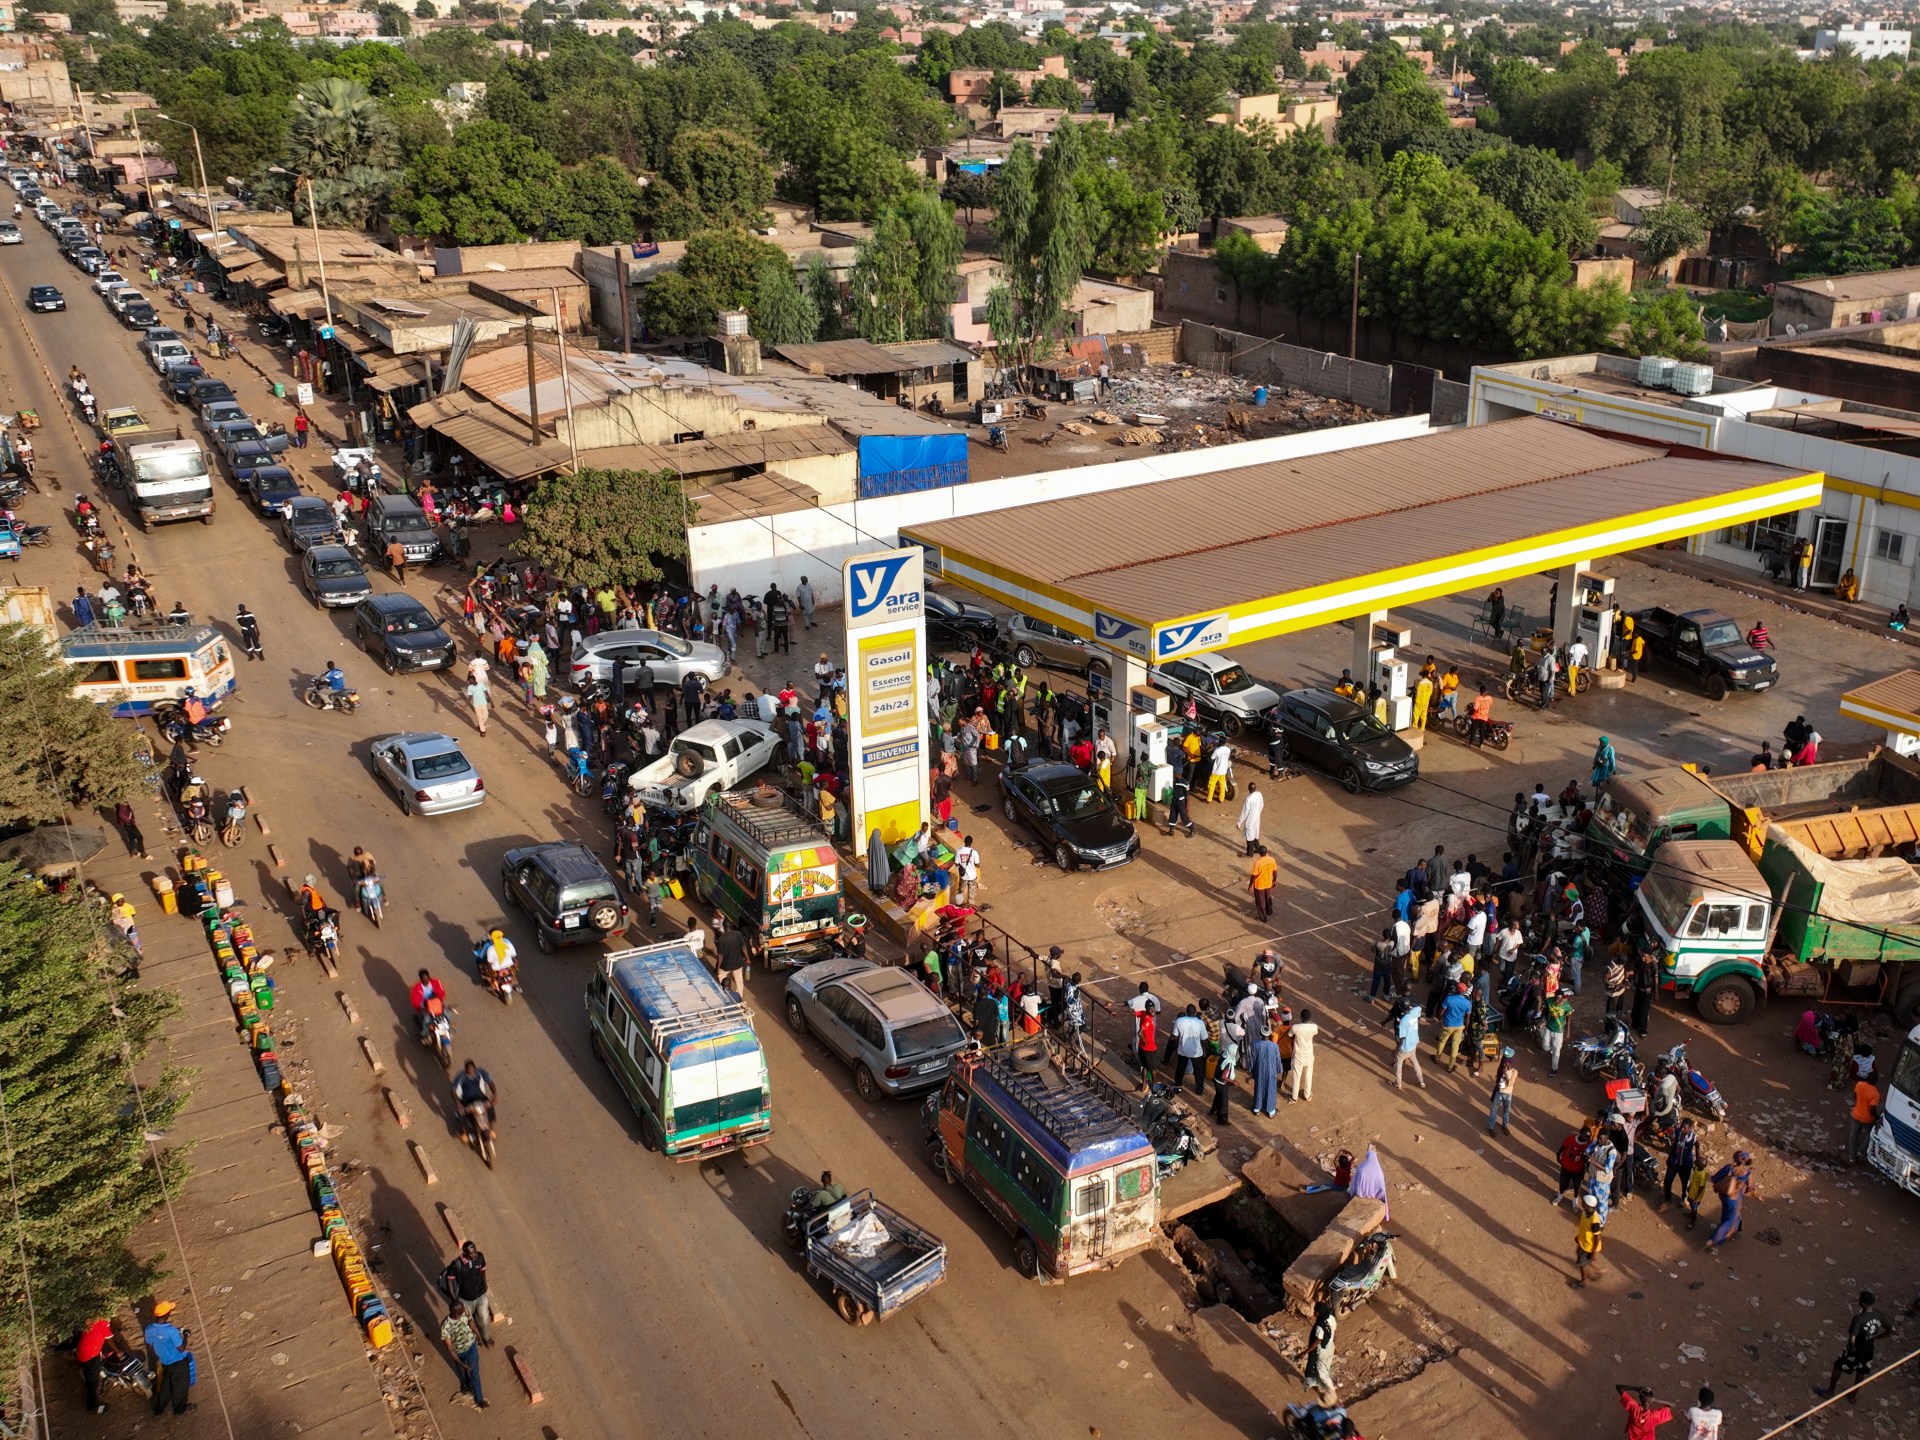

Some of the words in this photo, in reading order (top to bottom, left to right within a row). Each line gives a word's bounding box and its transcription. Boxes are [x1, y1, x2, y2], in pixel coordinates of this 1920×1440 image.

[887, 603, 919, 614] service
[1201, 638, 1222, 646] service
[1129, 646, 1146, 655] service
[869, 651, 911, 666] Gasoil
[1737, 655, 1764, 664] POLICE
[872, 675, 911, 687] Essence
[873, 699, 909, 714] 24h/24
[867, 743, 916, 762] BIENVENUE
